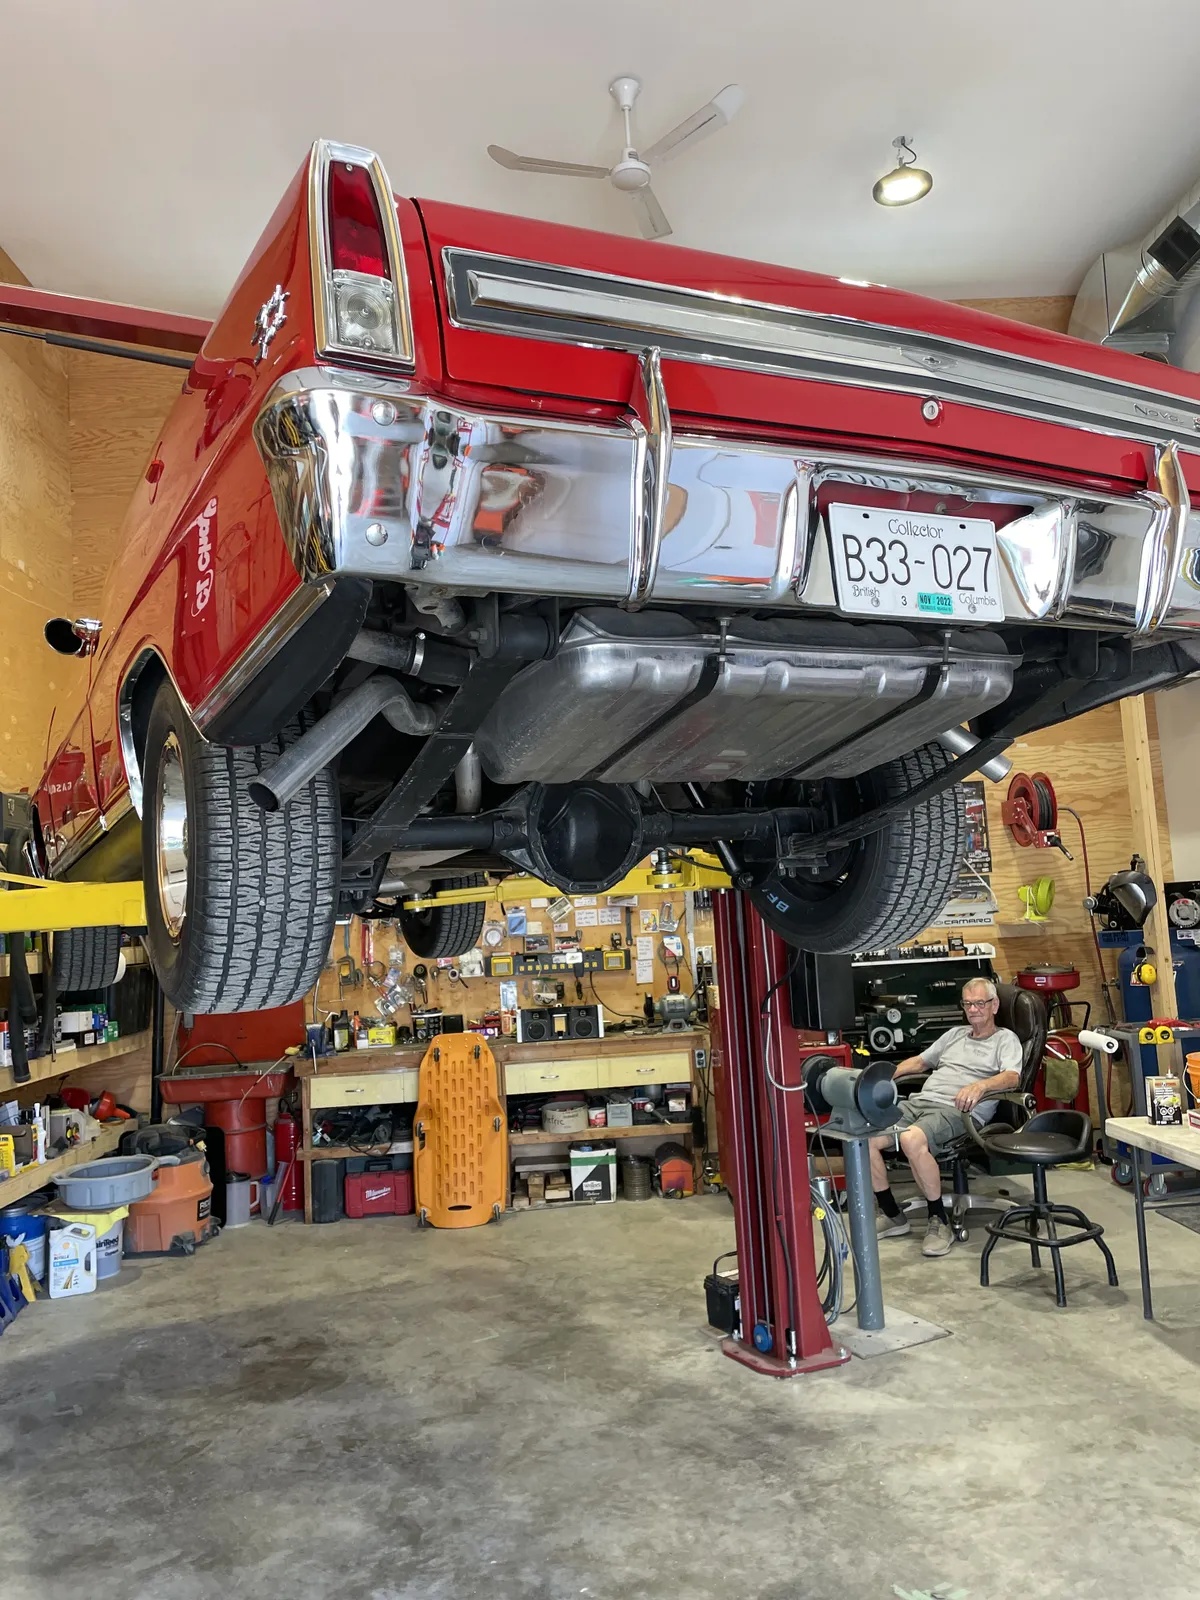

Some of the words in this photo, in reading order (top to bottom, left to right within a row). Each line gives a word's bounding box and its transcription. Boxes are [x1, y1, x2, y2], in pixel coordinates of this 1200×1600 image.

[888, 518, 944, 538] Collector
[842, 533, 992, 592] B33-027
[851, 584, 880, 598] British
[901, 595, 908, 606] 3
[919, 594, 932, 605] NOV
[936, 596, 951, 606] 2022
[958, 593, 998, 606] Columbia
